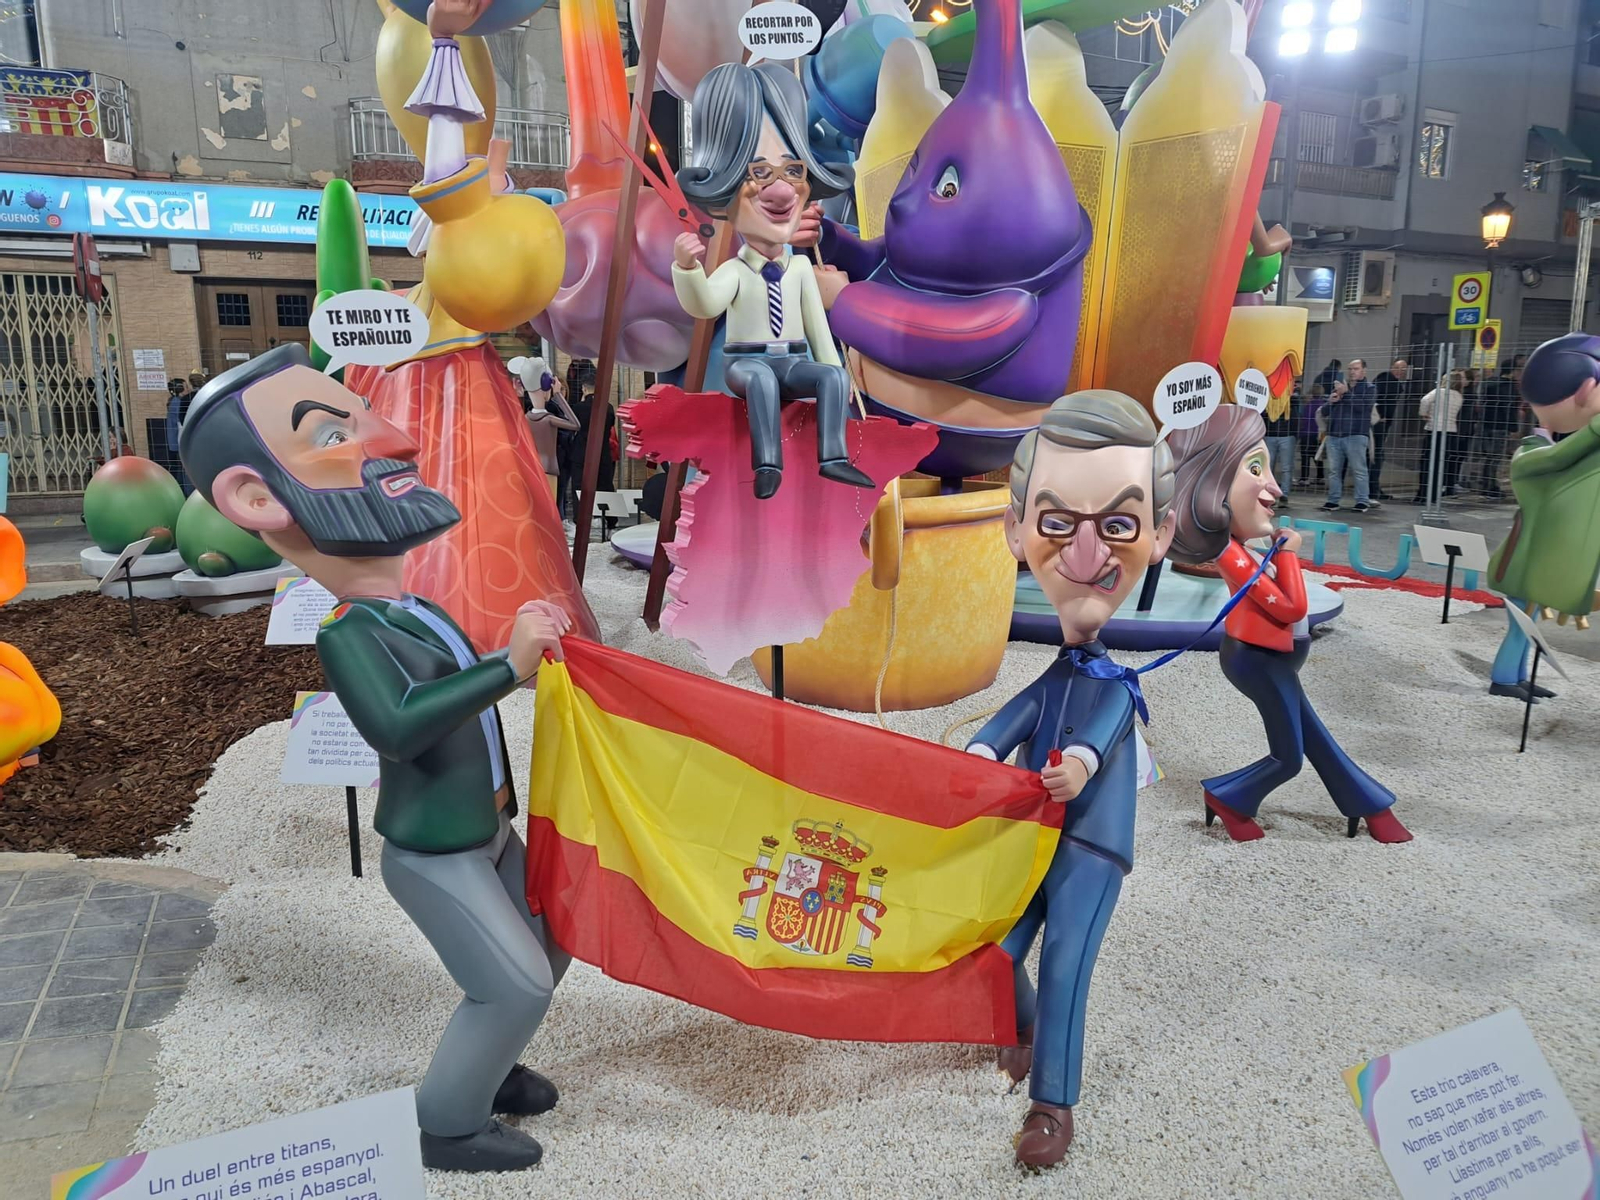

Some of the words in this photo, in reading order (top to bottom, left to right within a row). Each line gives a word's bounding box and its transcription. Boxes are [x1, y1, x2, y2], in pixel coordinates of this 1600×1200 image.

[745, 16, 793, 29] RECORTAR
[795, 16, 813, 27] POR
[749, 33, 766, 45] LOS
[768, 32, 804, 44] PUNTOS
[0, 212, 40, 223] GUENOS
[247, 251, 263, 260] 112
[1463, 286, 1477, 295] 30
[326, 310, 343, 325] TE
[345, 309, 382, 325] MIRO
[384, 309, 392, 323] Y
[394, 309, 411, 323] TE
[332, 328, 412, 347] ESPAÑOLIZO
[1166, 383, 1177, 397] YO
[1178, 379, 1195, 395] SOY
[1195, 374, 1212, 391] MÁS
[1172, 395, 1206, 415] ESPAÑOL
[312, 710, 319, 718] Si
[318, 730, 349, 738] societat
[336, 721, 349, 729] per
[321, 748, 349, 756] dividida
[1410, 1086, 1438, 1104] Este
[1436, 1077, 1458, 1094] trio
[1457, 1061, 1504, 1086] calavera,
[1407, 1115, 1423, 1129] no
[1424, 1106, 1445, 1122] sap
[1445, 1098, 1467, 1116] que
[1466, 1087, 1489, 1105] més
[1489, 1078, 1507, 1099] pot
[1402, 1129, 1443, 1155] Només
[1443, 1118, 1473, 1138] volen
[1471, 1106, 1499, 1126] xafar
[1499, 1099, 1516, 1115] als
[1422, 1154, 1441, 1175] per
[1442, 1145, 1458, 1163] tal
[1458, 1129, 1501, 1156] d'arribar
[1501, 1123, 1513, 1137] al
[1497, 1148, 1517, 1168] per
[1515, 1145, 1523, 1155] a
[149, 1177, 175, 1196] Un
[181, 1162, 221, 1187] duel
[227, 1152, 275, 1175] entre
[281, 1138, 336, 1161] titans,
[229, 1179, 252, 1197] és
[258, 1167, 296, 1190] més
[301, 1143, 384, 1178] espanyol.
[1463, 1175, 1509, 1200] enguany
[1509, 1167, 1523, 1183] no
[1522, 1160, 1538, 1175] ha
[1537, 1148, 1567, 1171] pogut
[300, 1167, 376, 1200] Abascal,
